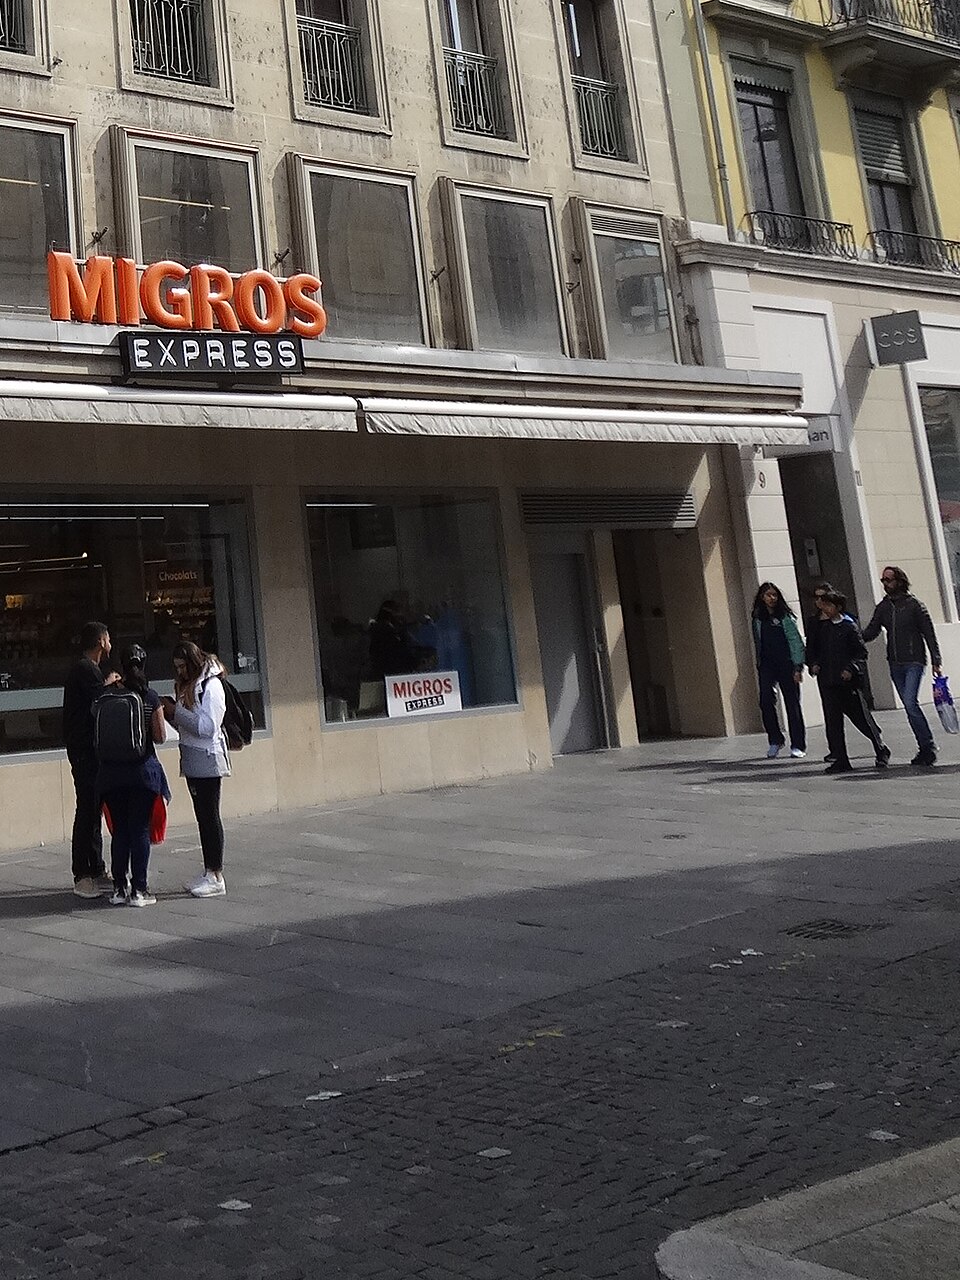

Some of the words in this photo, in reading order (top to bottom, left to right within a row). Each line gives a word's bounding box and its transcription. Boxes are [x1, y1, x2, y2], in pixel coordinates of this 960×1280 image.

[47, 251, 326, 339] MIGROS
[878, 328, 918, 348] COS
[133, 339, 297, 368] EXPRESS
[807, 430, 829, 442] an
[758, 471, 767, 489] 9
[393, 678, 453, 698] MIGROS
[406, 696, 443, 711] EXPRESS
